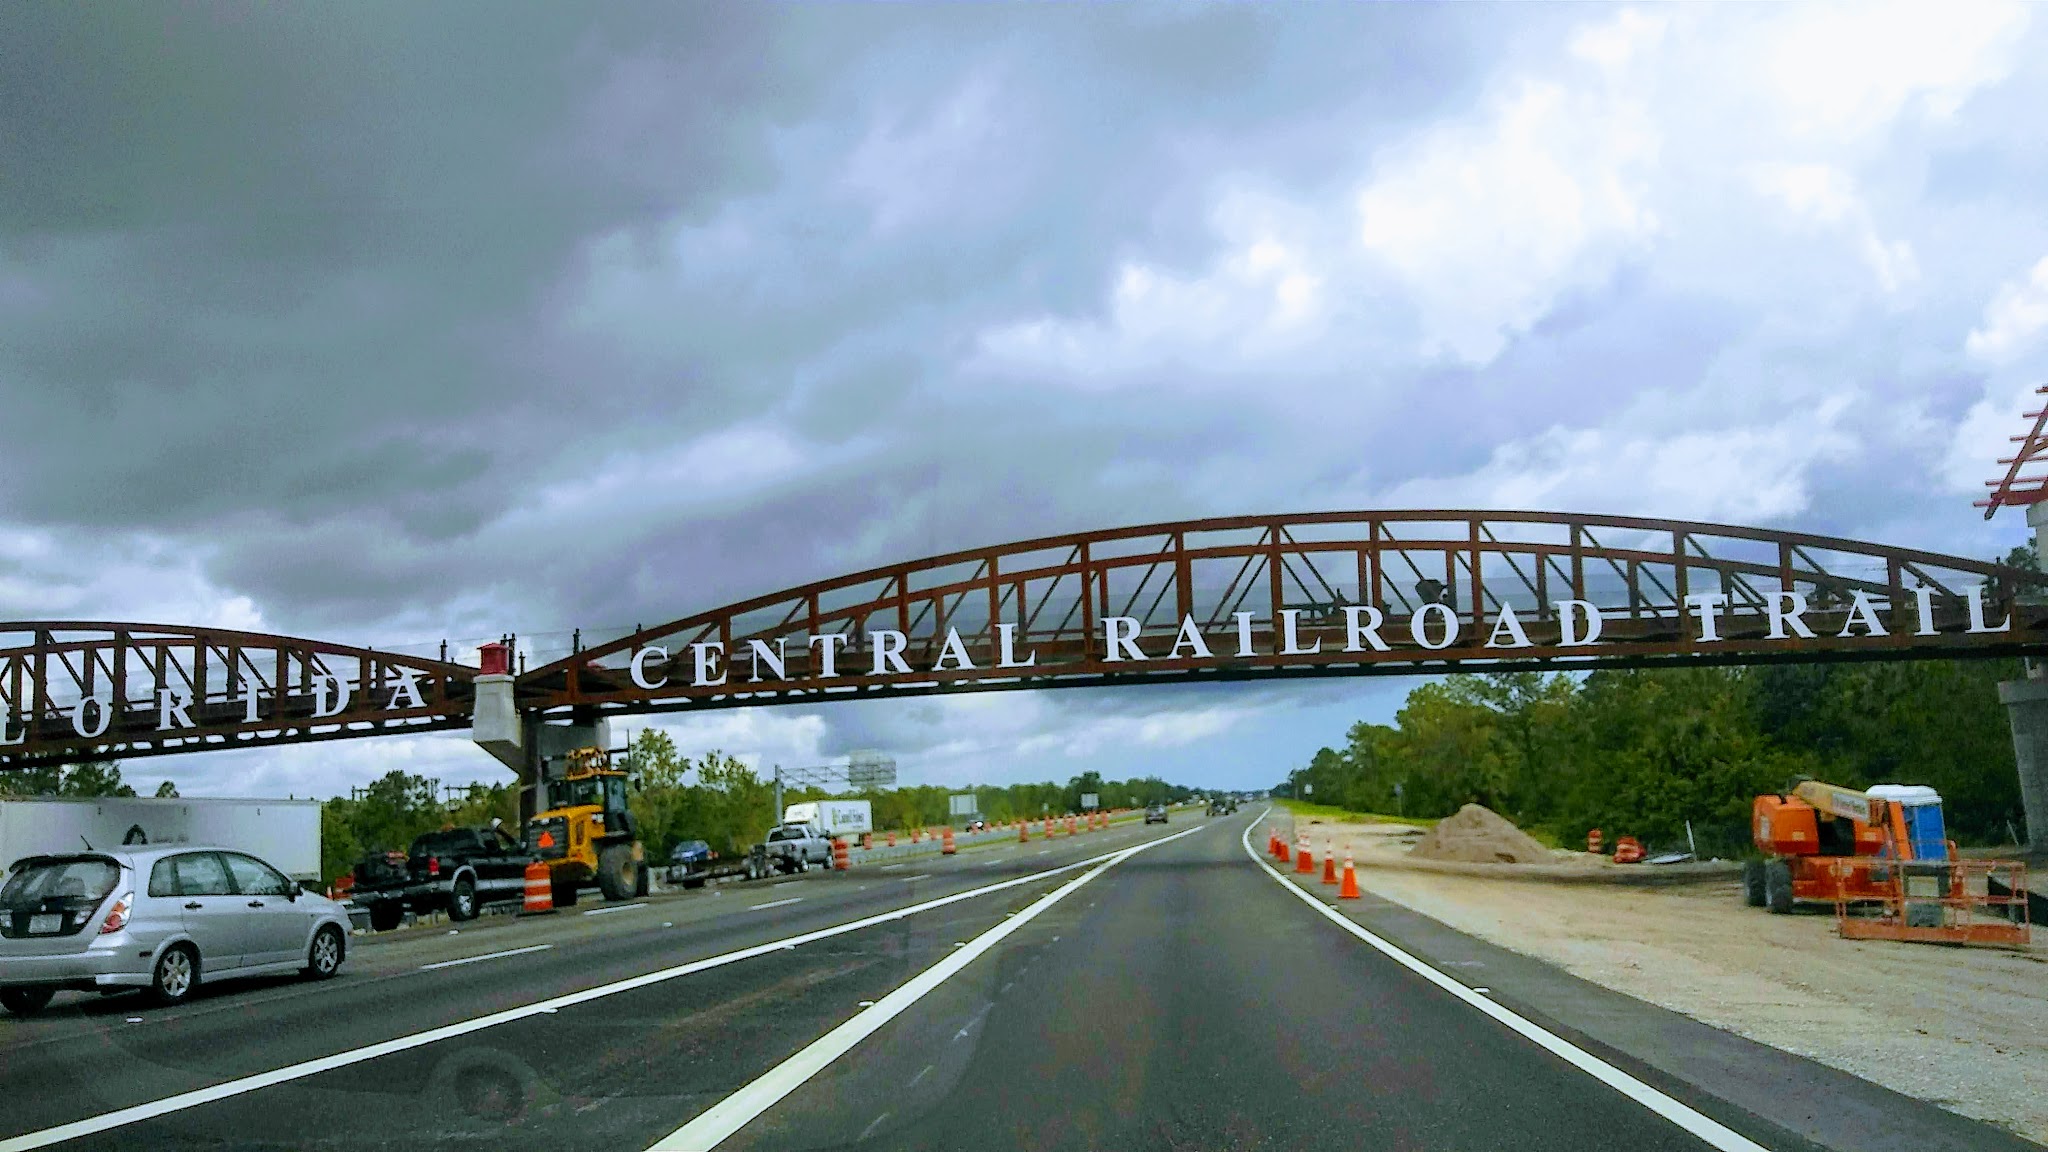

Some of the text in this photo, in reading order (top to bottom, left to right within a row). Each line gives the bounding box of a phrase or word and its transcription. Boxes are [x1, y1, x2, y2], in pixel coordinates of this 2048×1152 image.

[630, 623, 1036, 690] CENTRAL
[1100, 600, 1604, 663] RAILROAD
[1684, 584, 2011, 643] TRAIL
